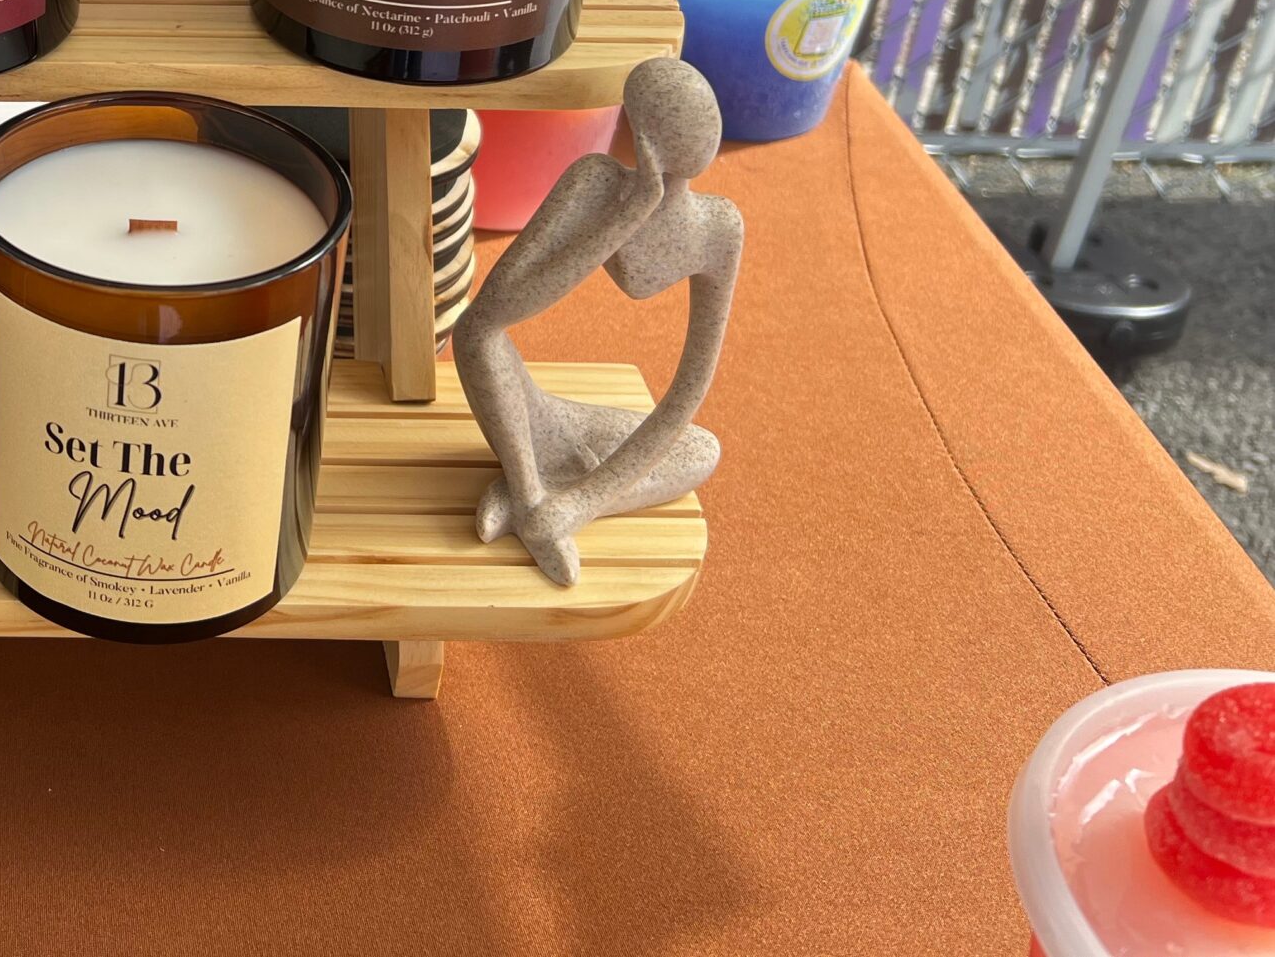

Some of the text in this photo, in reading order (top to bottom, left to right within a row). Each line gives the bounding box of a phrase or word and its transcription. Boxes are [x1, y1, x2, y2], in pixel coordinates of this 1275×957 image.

[346, 3, 360, 14] of
[362, 6, 421, 23] Nectarine
[434, 12, 491, 24] Patchouli
[503, 2, 537, 18] Vanilla
[382, 23, 396, 34] Oz
[114, 362, 162, 410] 13
[86, 407, 178, 428] THIRTEEN AVE
[44, 421, 191, 476] Set The
[68, 471, 195, 540] Mood
[6, 531, 251, 595] Fine Fragrance of Smokey Lavender Vanilla
[28, 521, 224, 577] Natural Coconut Wax Candle
[100, 592, 141, 608] Oz 312
